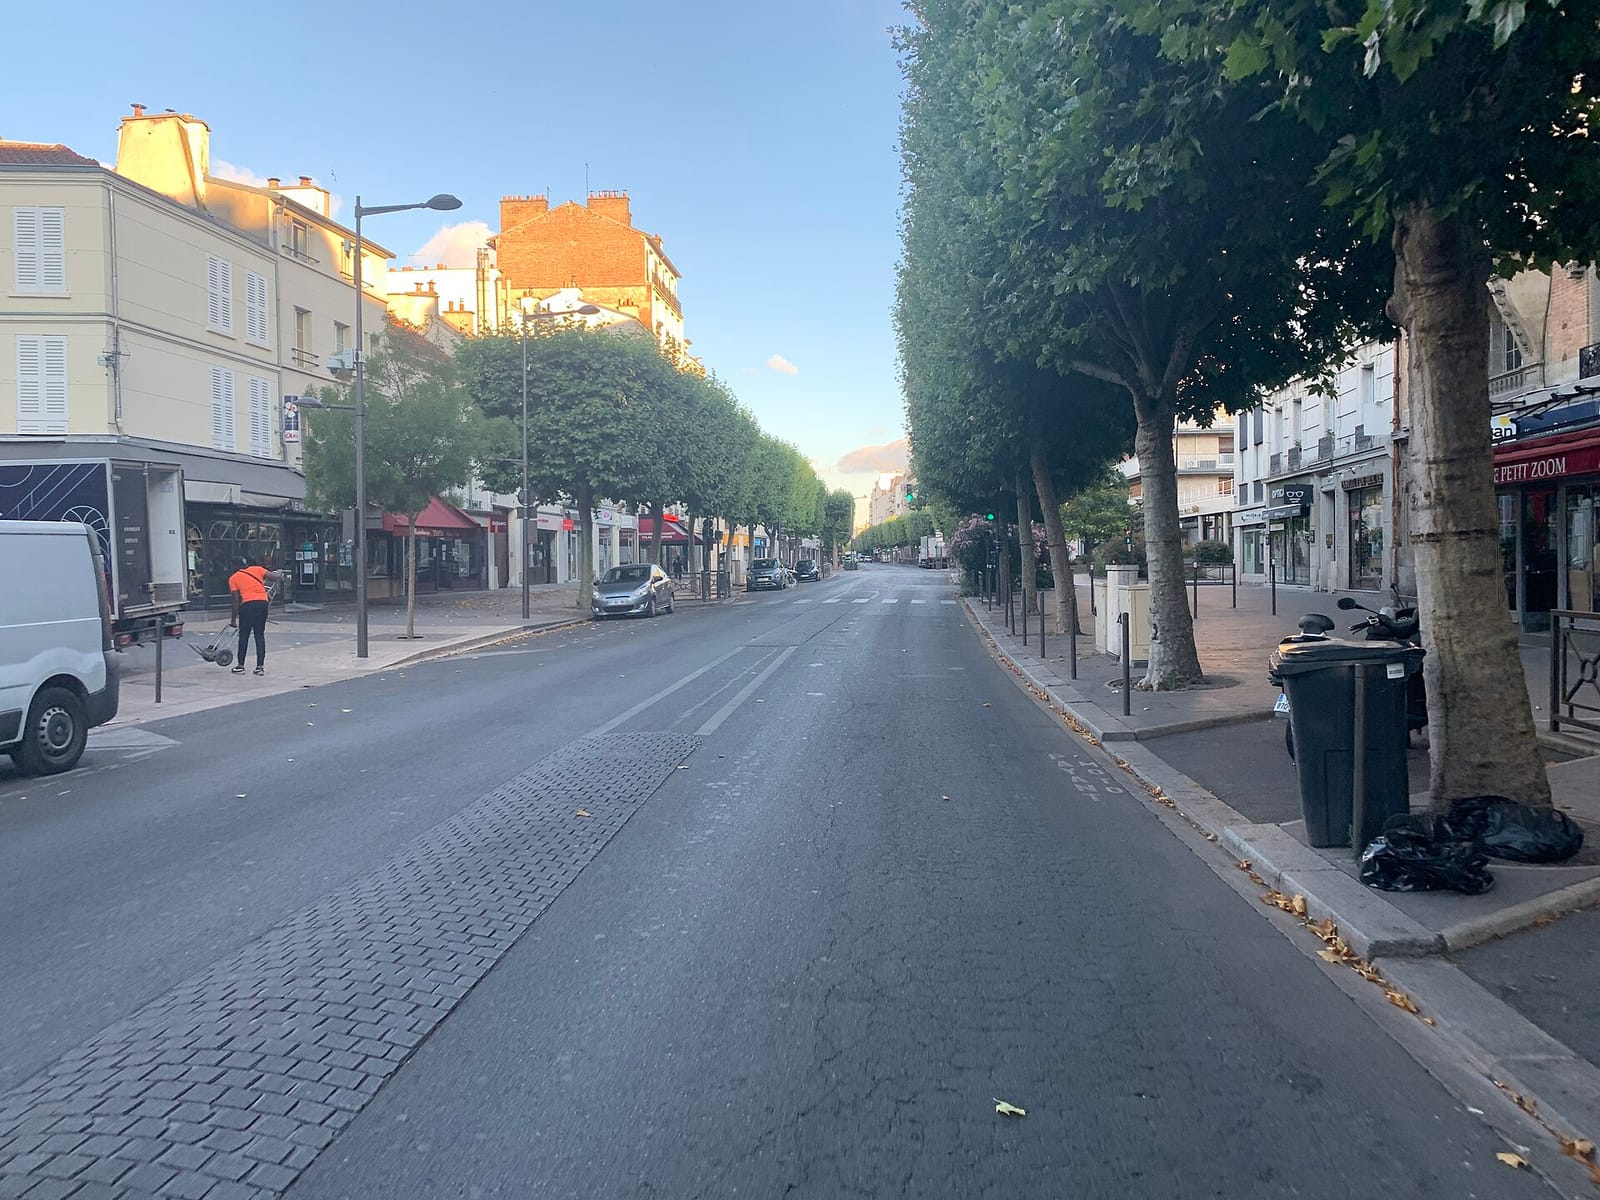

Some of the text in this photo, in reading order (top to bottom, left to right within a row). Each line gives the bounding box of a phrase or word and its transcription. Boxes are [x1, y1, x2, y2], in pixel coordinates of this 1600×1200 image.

[1491, 427, 1513, 439] an
[1501, 464, 1529, 481] PETIT
[1531, 457, 1566, 477] ZOOM
